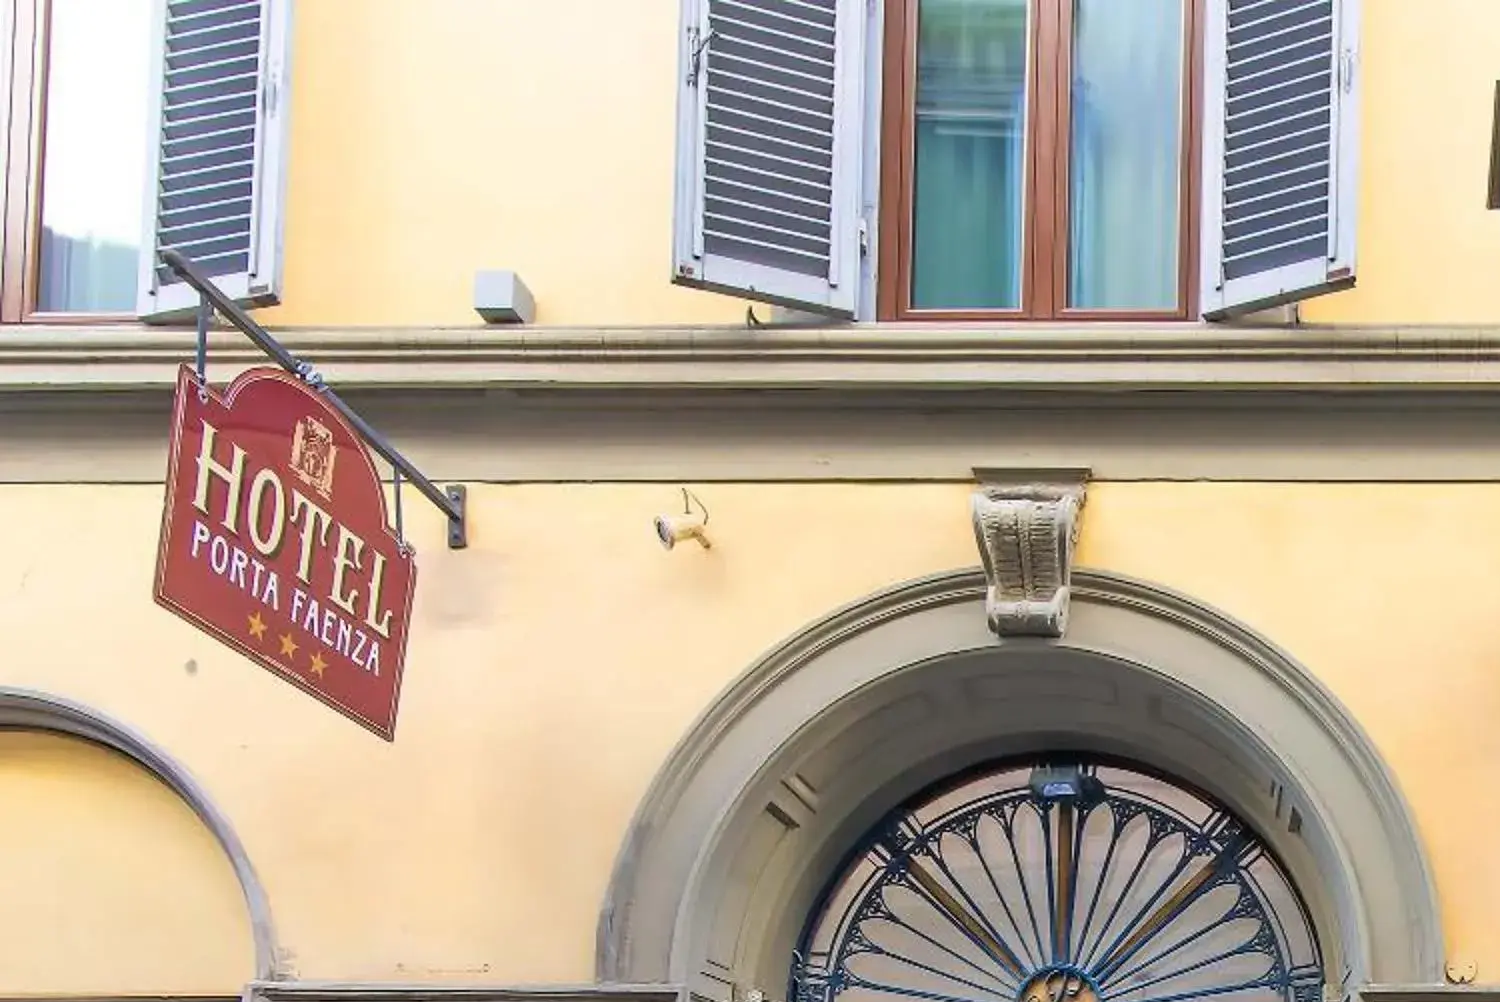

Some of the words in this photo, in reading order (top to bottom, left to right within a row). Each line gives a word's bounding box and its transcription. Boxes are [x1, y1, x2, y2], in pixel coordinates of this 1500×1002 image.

[191, 418, 393, 640] HOTEL
[191, 520, 279, 611] PORTA
[290, 587, 380, 677] FAENZA
